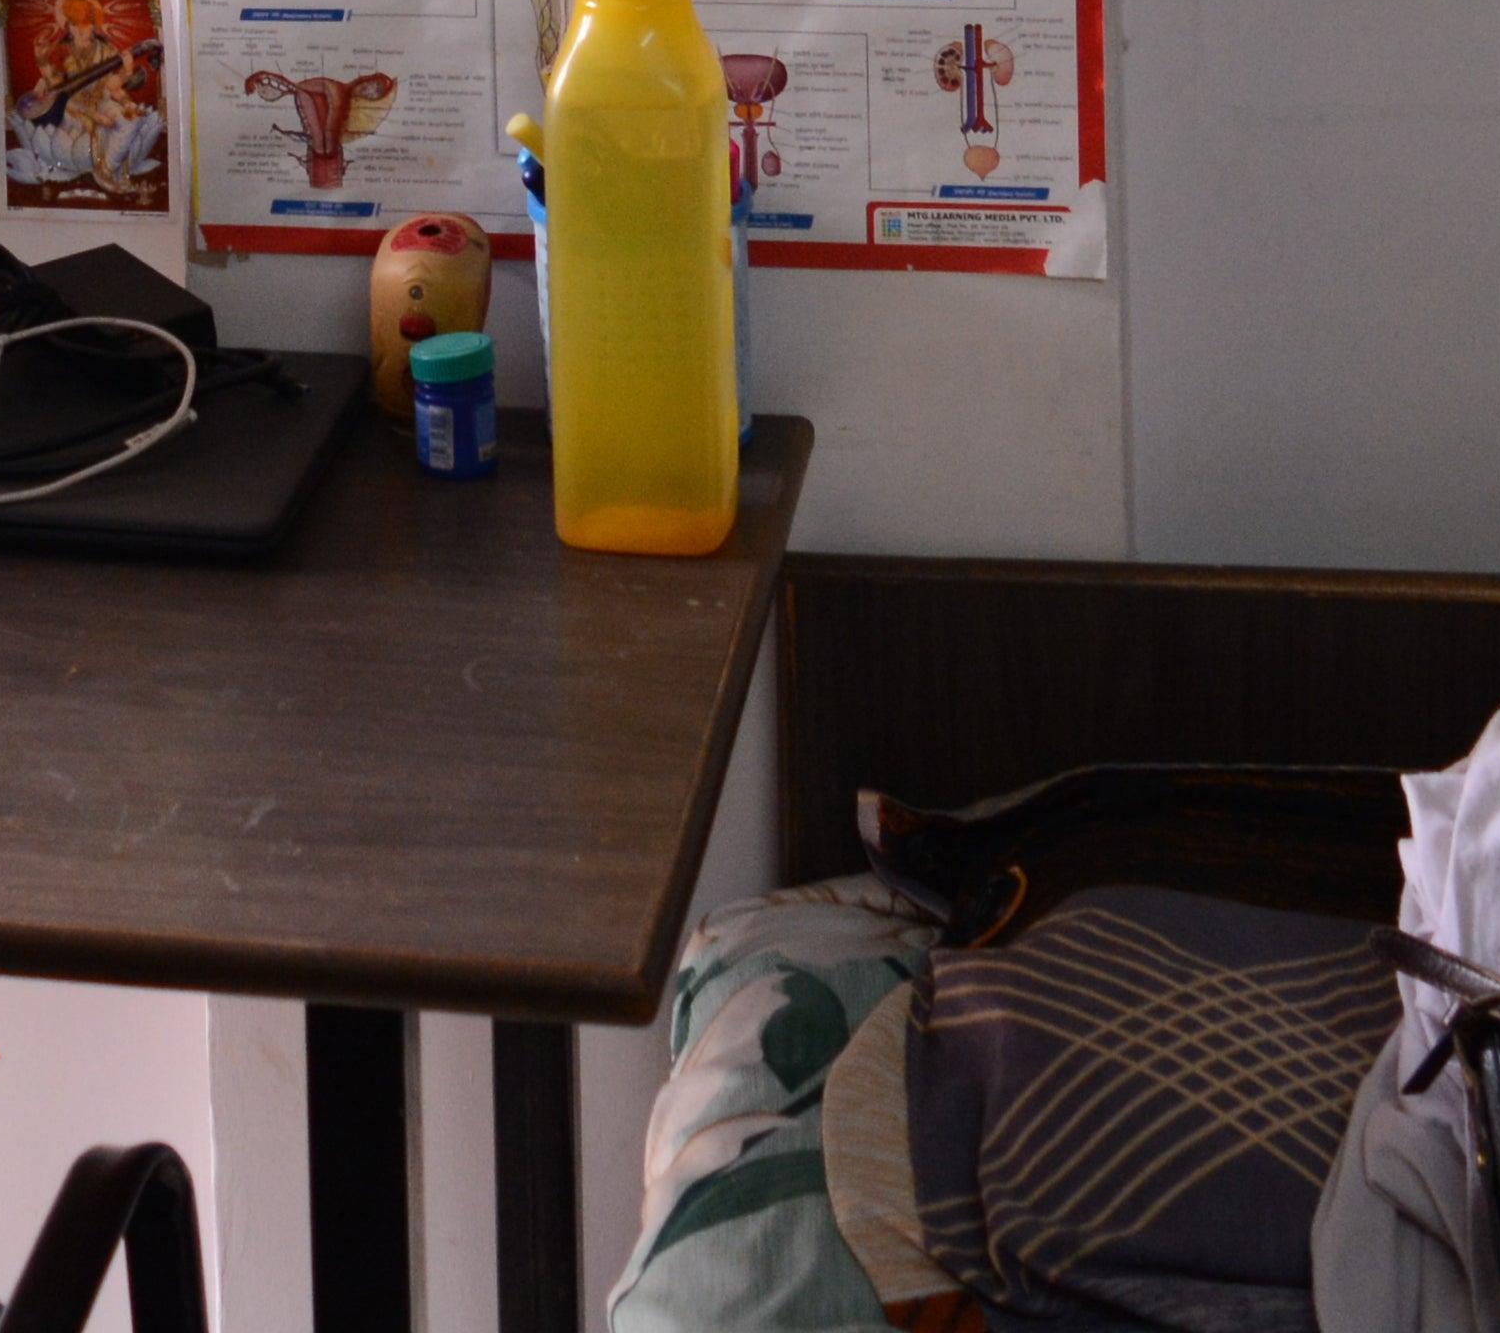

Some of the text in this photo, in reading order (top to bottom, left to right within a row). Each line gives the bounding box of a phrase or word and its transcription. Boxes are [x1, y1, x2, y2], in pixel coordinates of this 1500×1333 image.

[906, 211, 929, 220] MTG
[930, 212, 983, 222] LEARNING
[985, 213, 1017, 222] MEDIA
[1043, 215, 1066, 225] LTD.
